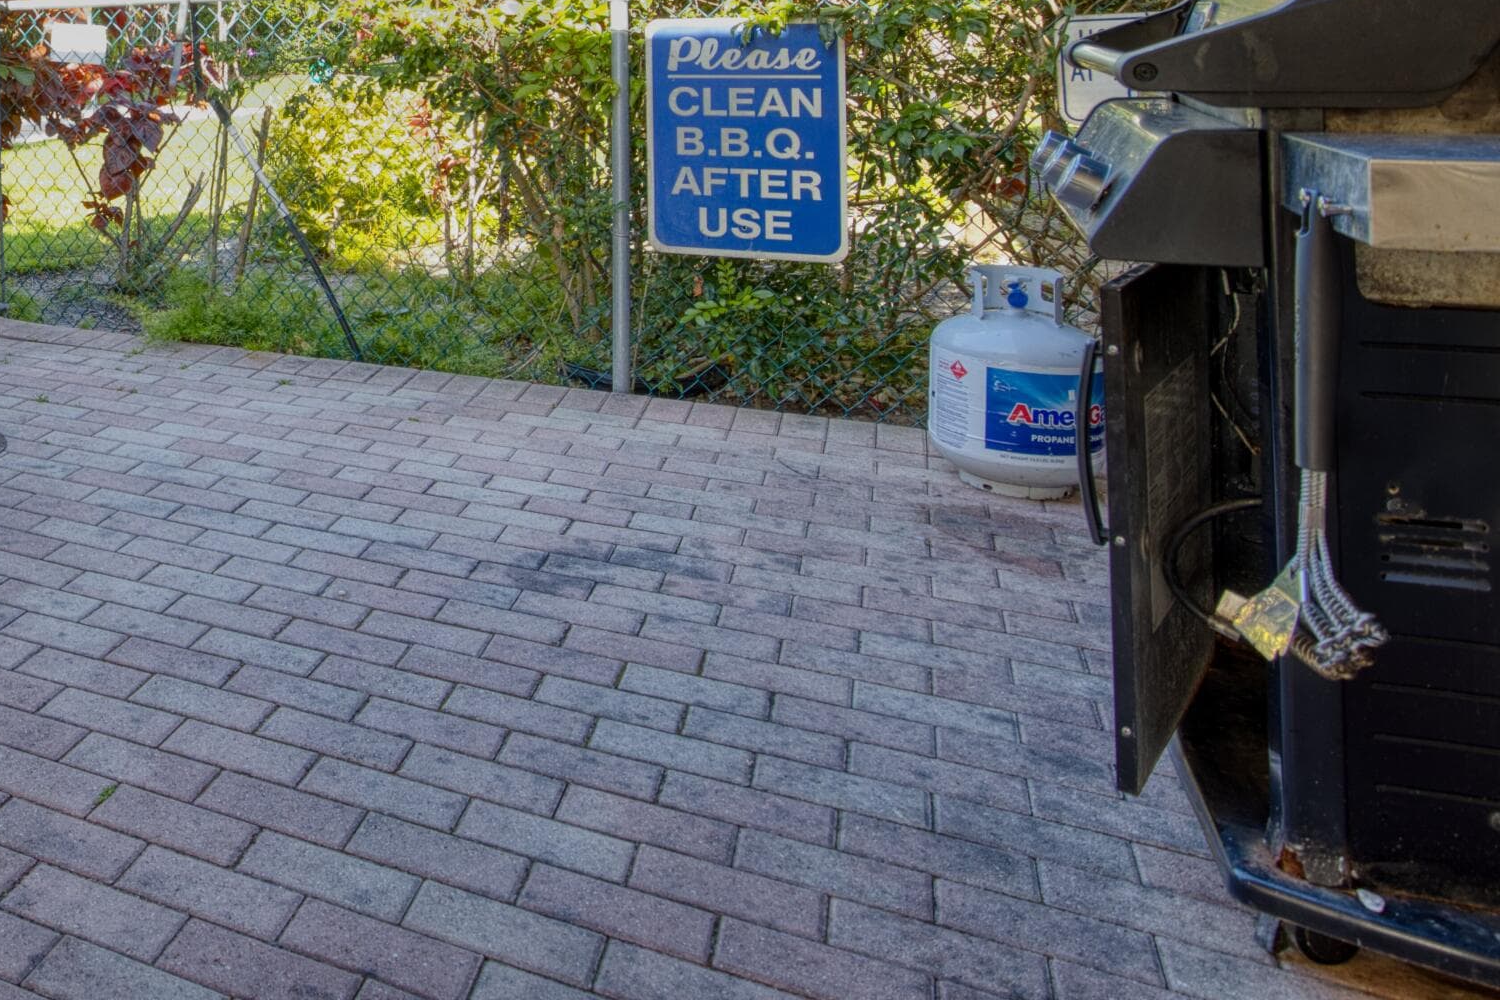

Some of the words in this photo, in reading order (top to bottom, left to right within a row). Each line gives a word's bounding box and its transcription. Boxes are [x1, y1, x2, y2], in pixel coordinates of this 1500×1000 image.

[667, 36, 821, 71] Please
[668, 86, 822, 118] CLEAN
[676, 127, 815, 160] B.B.Q.
[671, 166, 822, 201] AFTER
[699, 207, 793, 241] USE
[1031, 434, 1075, 444] PROPANE
